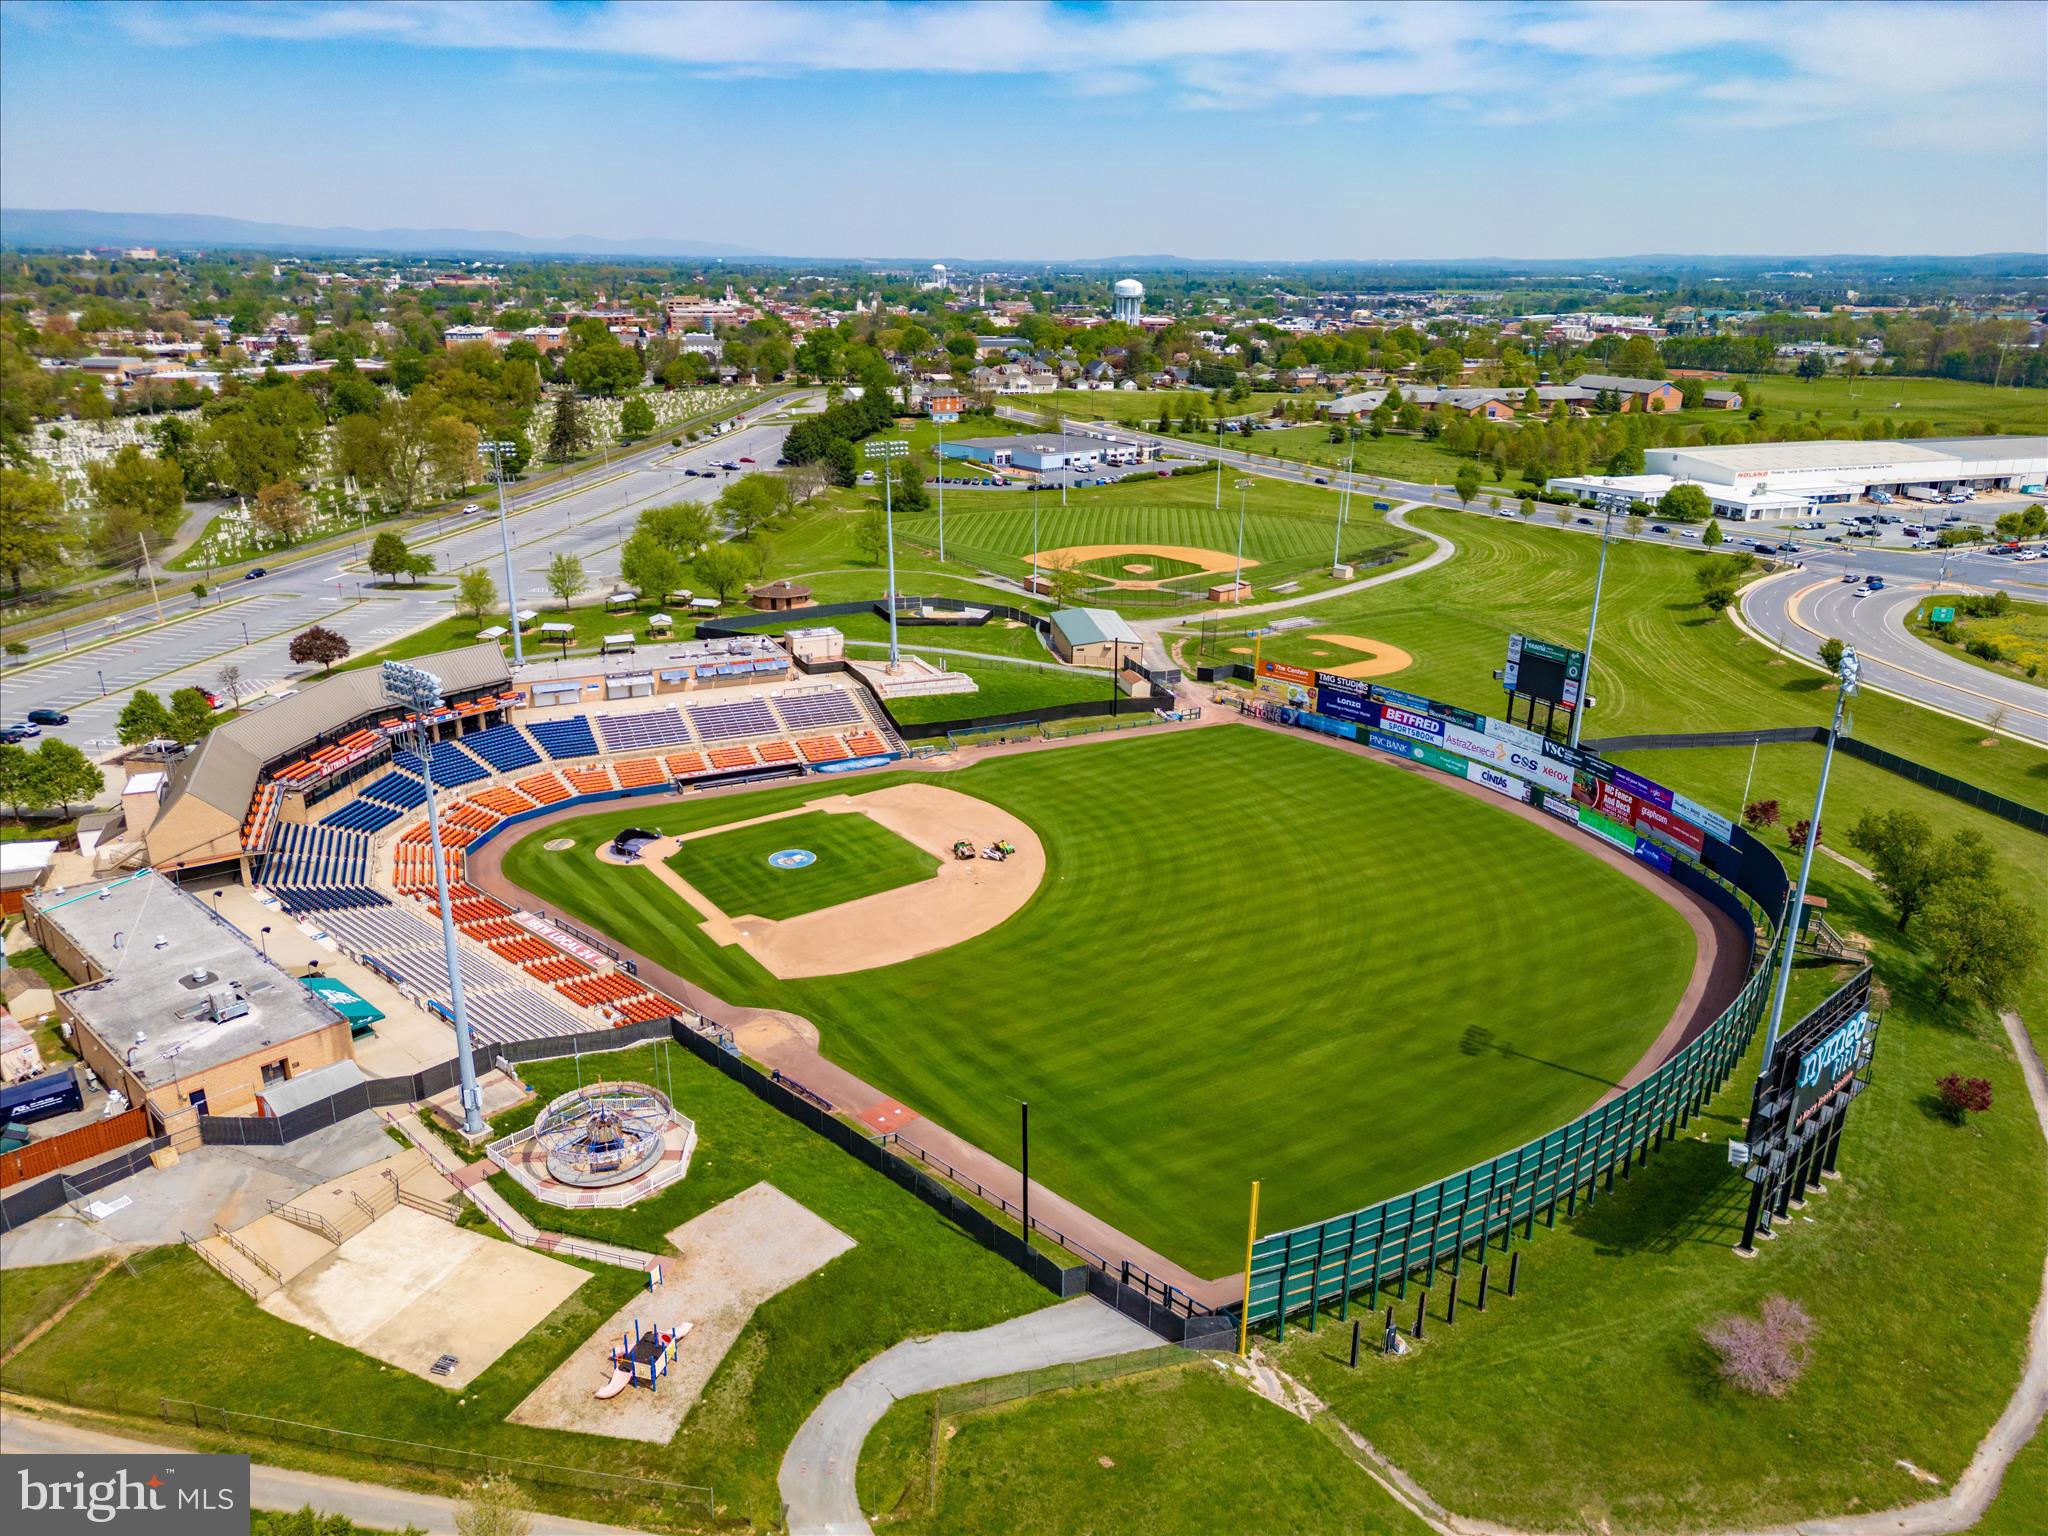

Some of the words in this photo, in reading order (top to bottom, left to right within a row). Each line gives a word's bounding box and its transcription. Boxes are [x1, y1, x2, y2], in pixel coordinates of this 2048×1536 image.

[1737, 471, 1769, 479] NOLAND
[1318, 673, 1336, 683] TMG
[1337, 697, 1361, 709] Lonza
[1386, 707, 1440, 733] BETFRED
[1388, 723, 1435, 743] SPORTSBOOK
[1445, 735, 1495, 759] AstraZeneca
[322, 755, 348, 777] MATTRESS
[1542, 766, 1568, 783] xerox
[1614, 788, 1633, 804] Fence
[1641, 806, 1668, 825] graphcom
[552, 931, 580, 952] LOCAL
[576, 948, 597, 960] 24
[1797, 1011, 1869, 1088] nymeo
